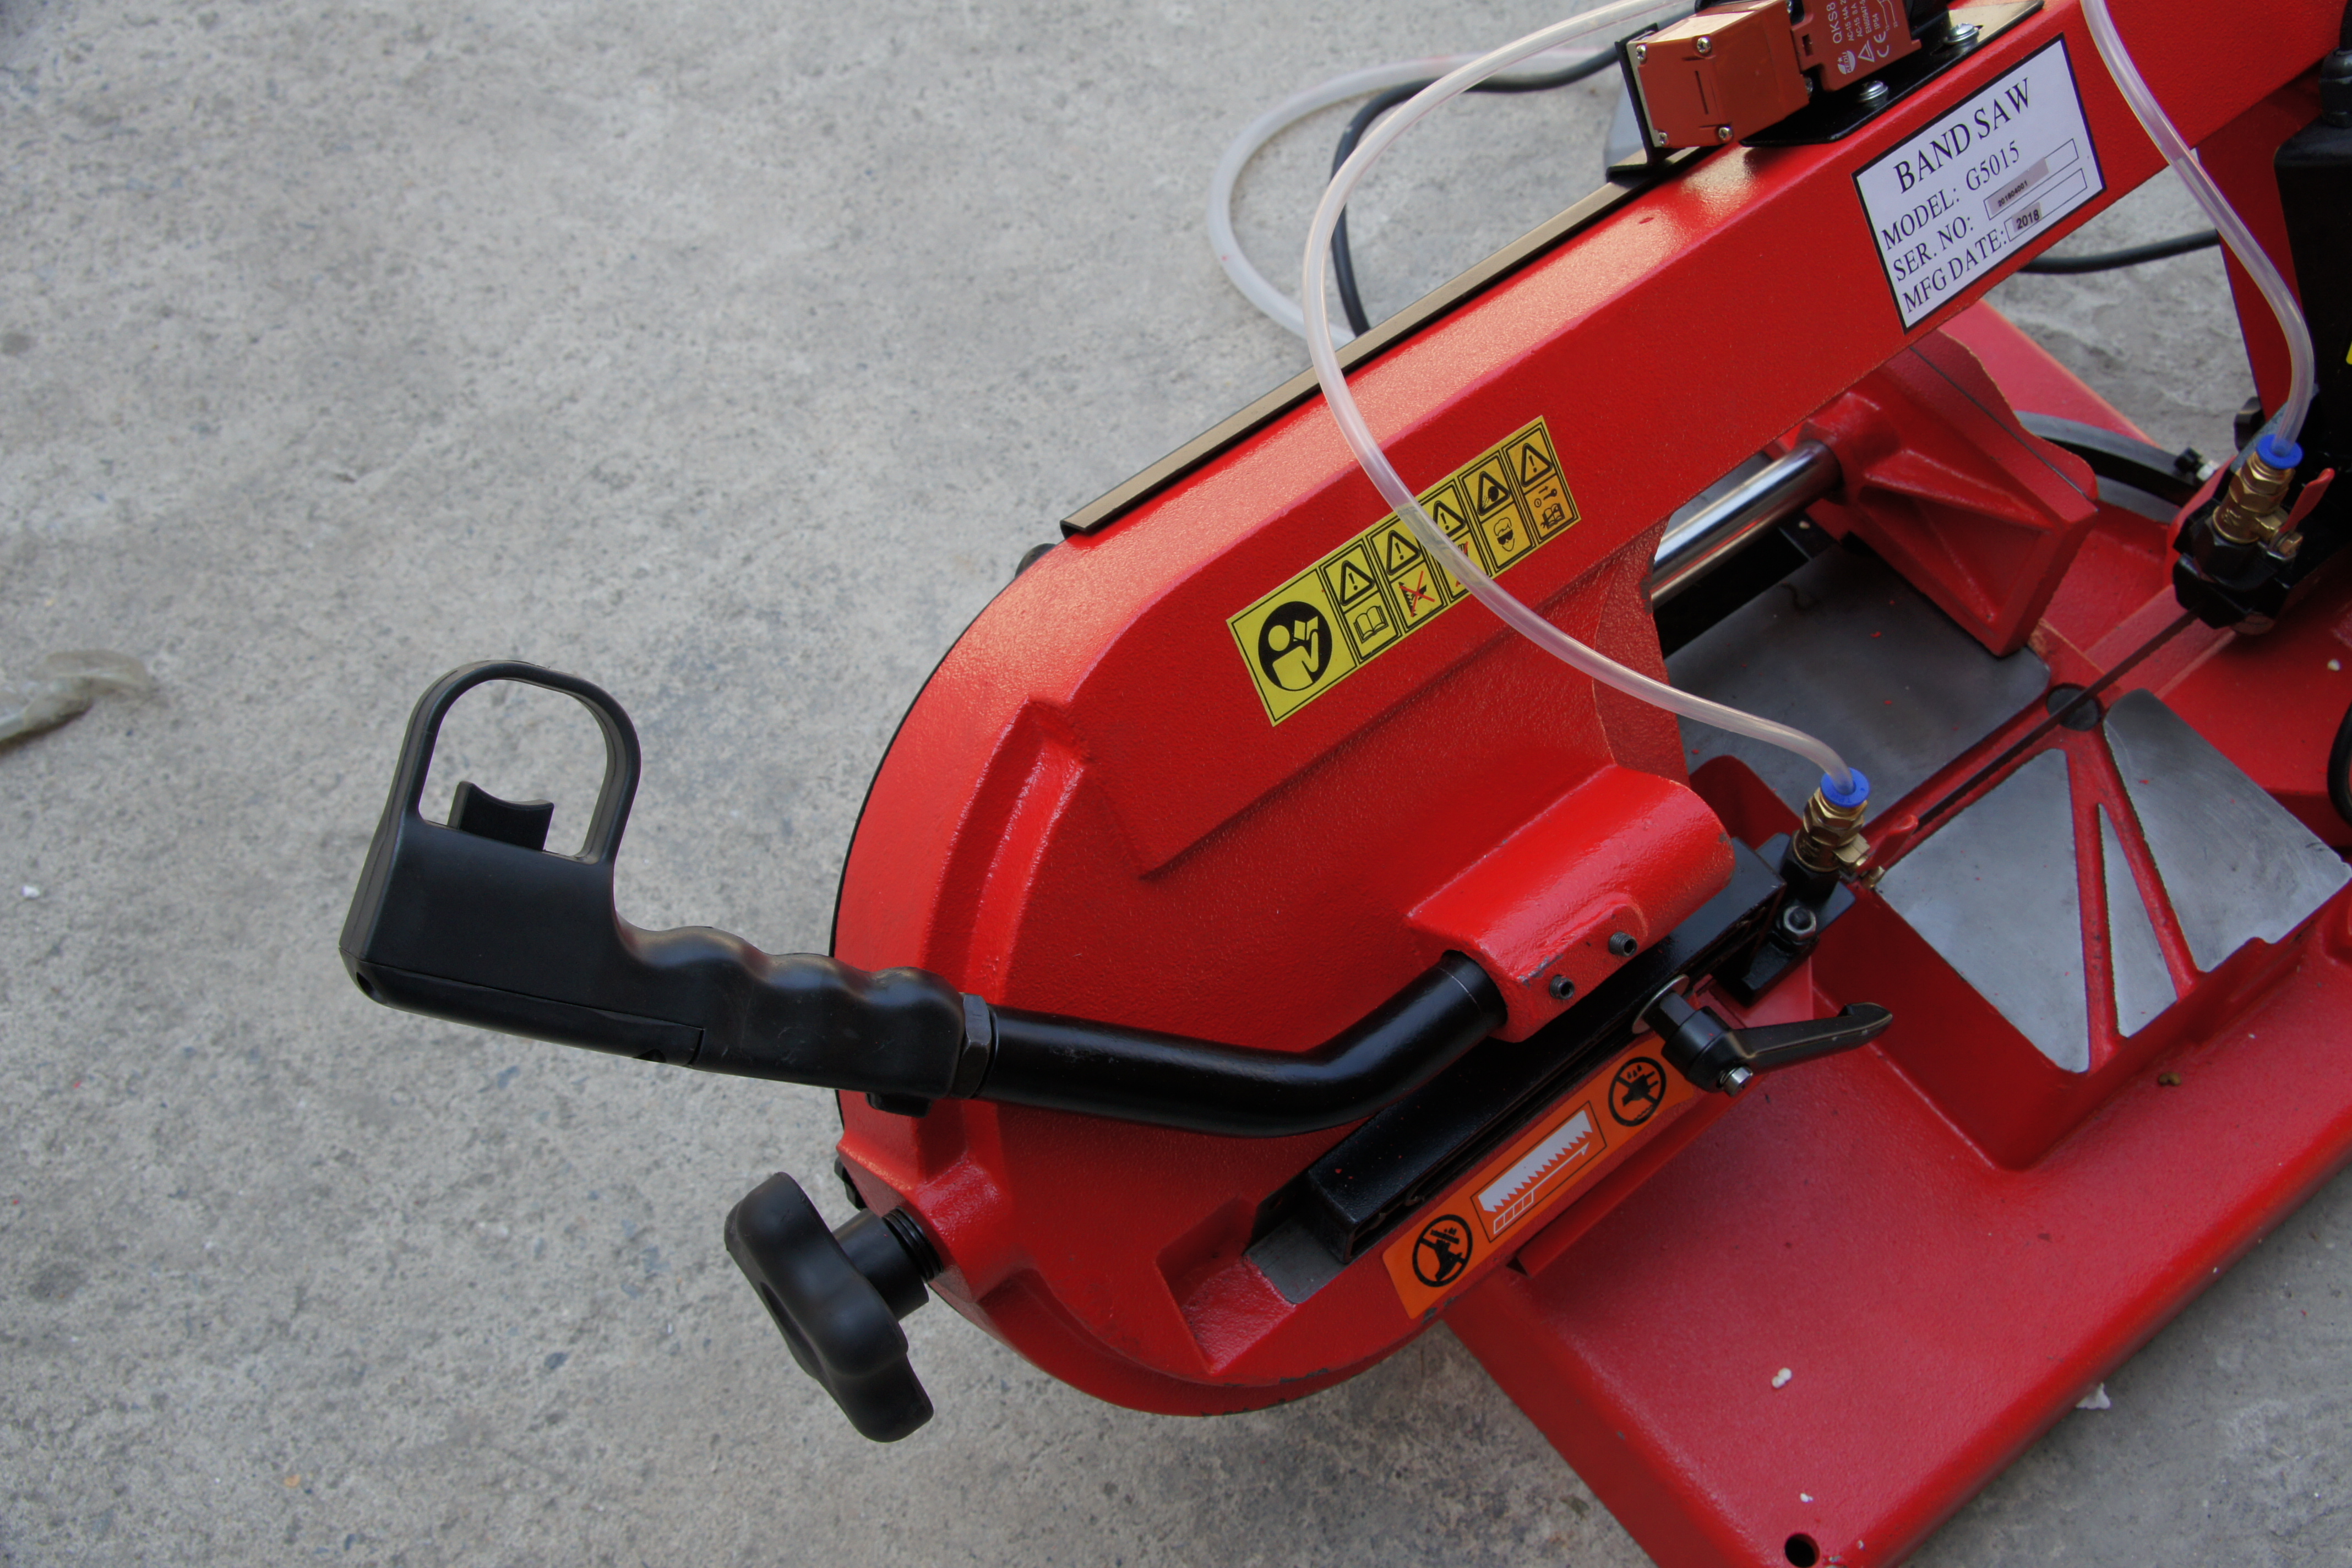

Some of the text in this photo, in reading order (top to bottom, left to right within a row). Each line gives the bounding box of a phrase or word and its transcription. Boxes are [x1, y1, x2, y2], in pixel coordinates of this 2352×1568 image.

[1826, 2, 1842, 43] QKS8
[1845, 21, 1854, 41] AC-15
[1854, 18, 1863, 37] AC-15
[1893, 77, 2029, 194] BAND SAW
[1882, 140, 2019, 251] MODEL: G5015
[1893, 180, 2028, 282] SER. NO: 201804001
[1902, 209, 2040, 313] MFG DATE: 2018
